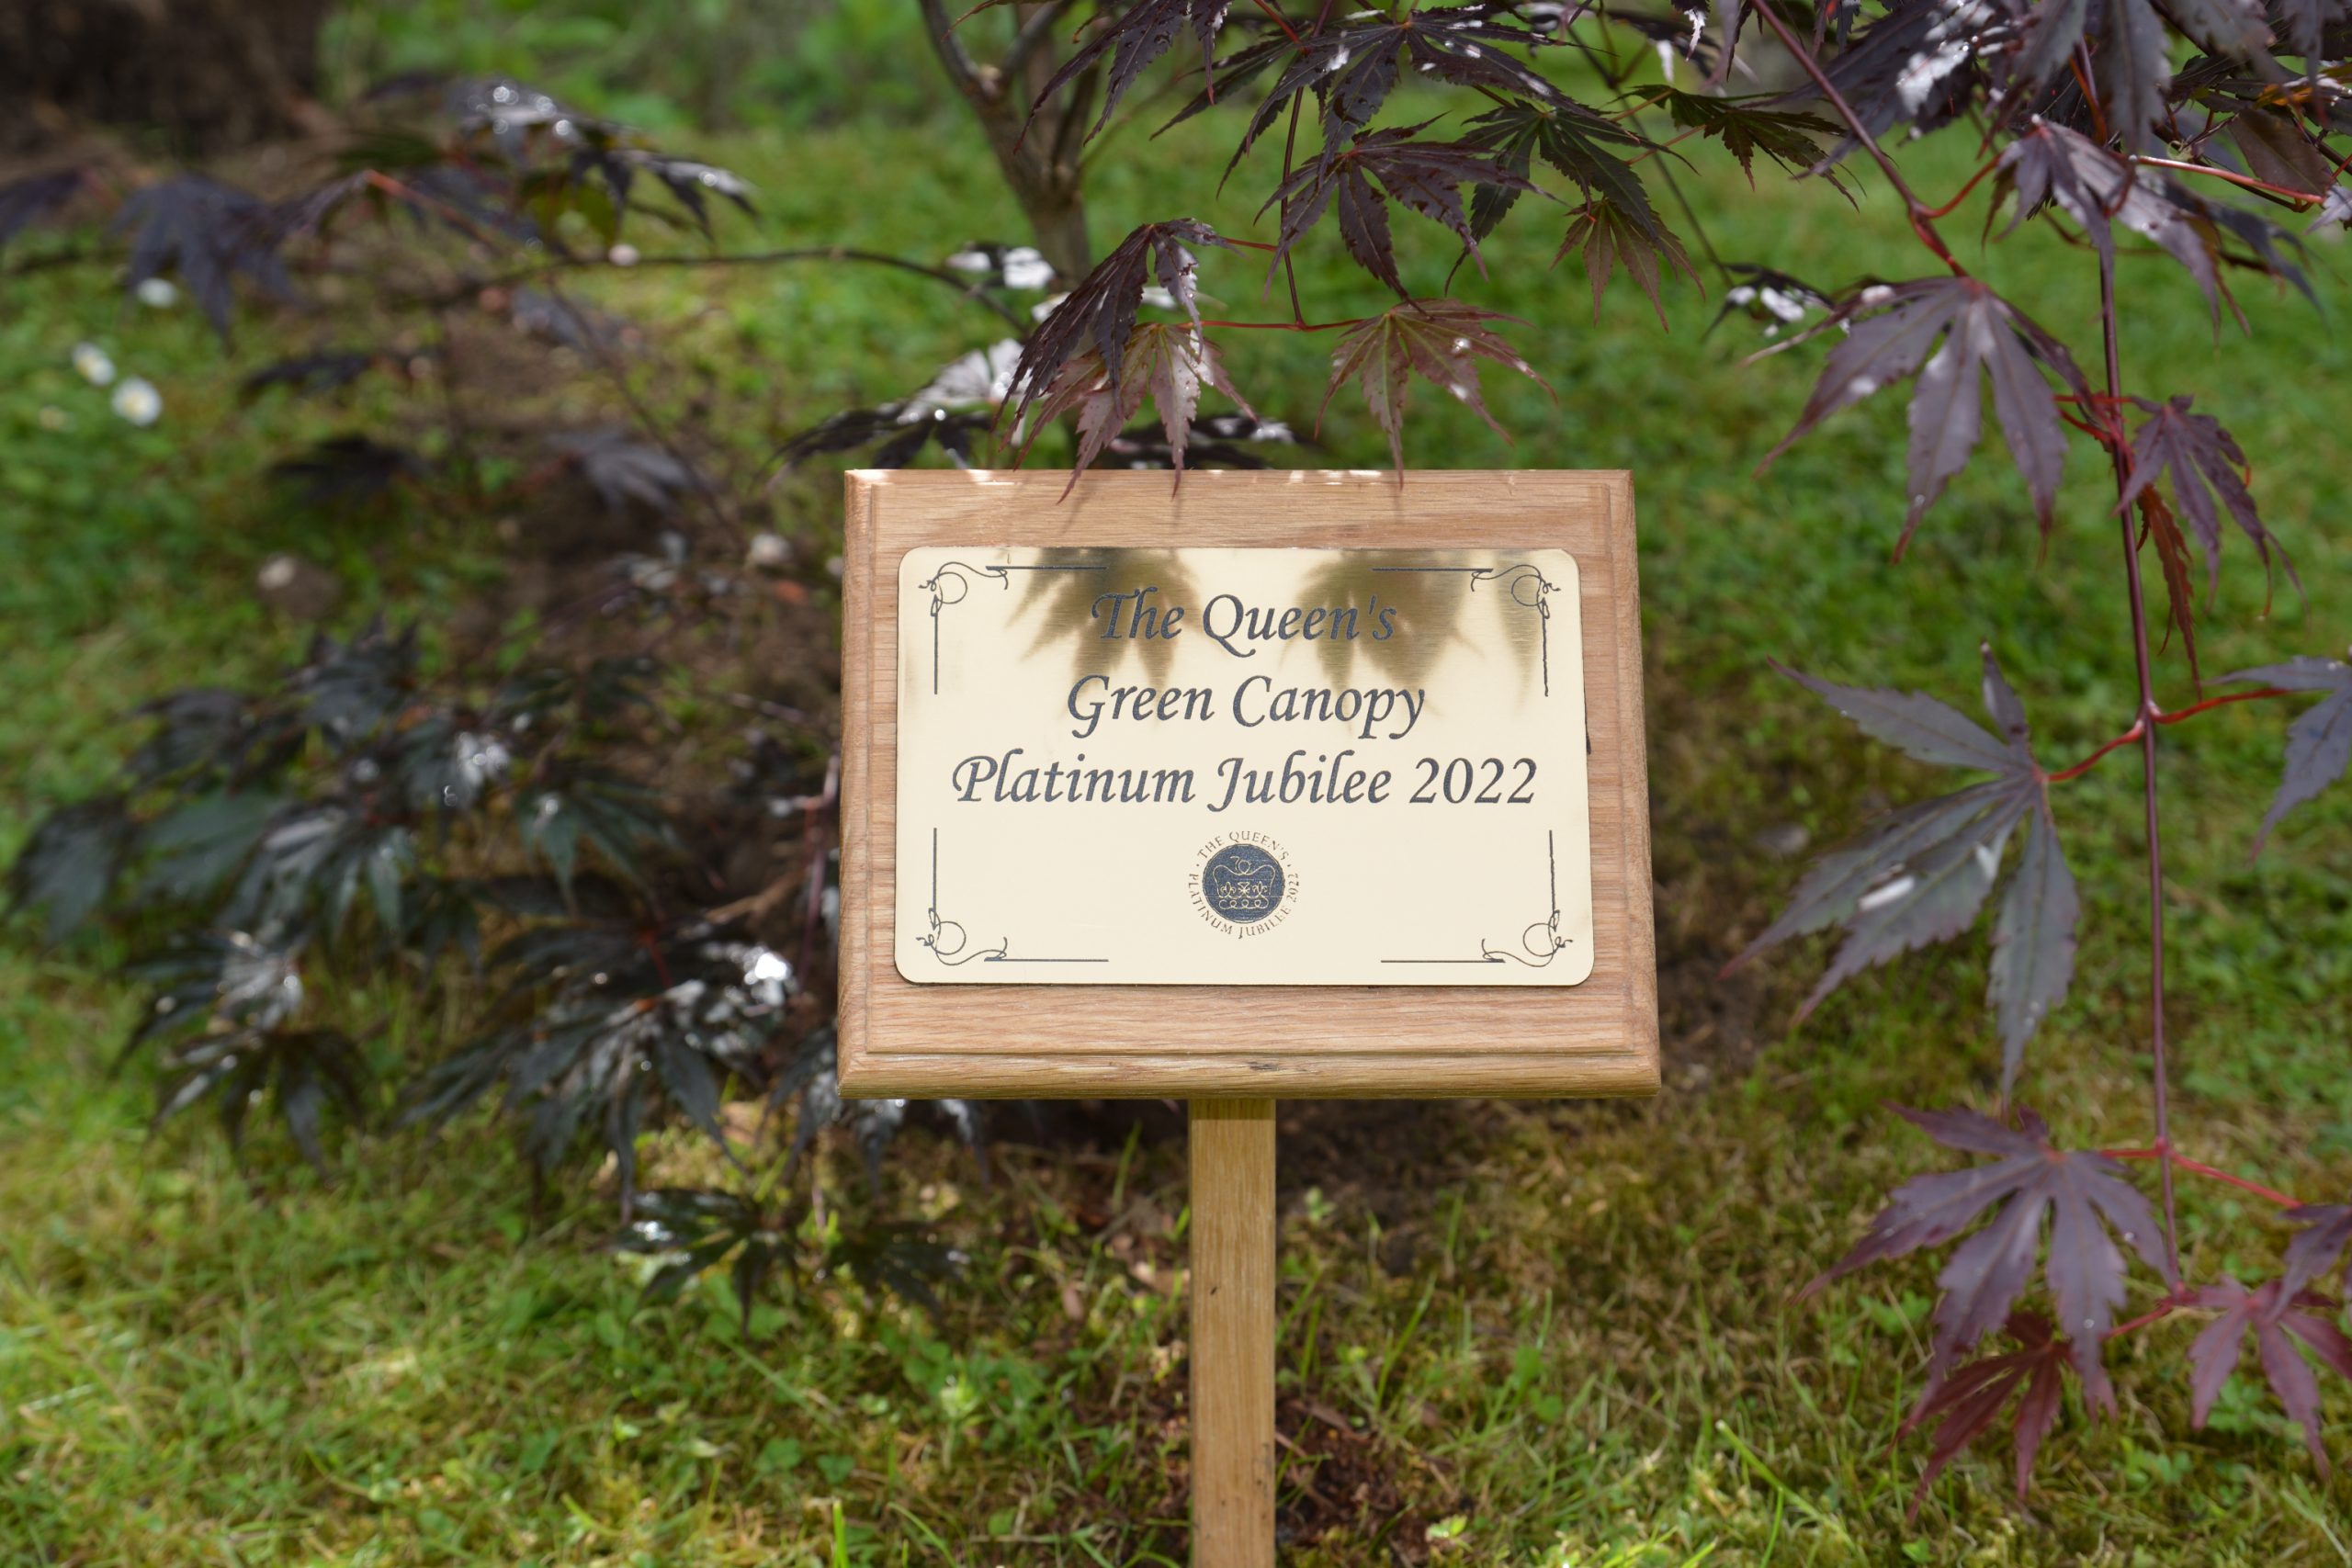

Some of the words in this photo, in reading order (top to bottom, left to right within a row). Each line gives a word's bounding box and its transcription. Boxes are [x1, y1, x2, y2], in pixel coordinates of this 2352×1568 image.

[1091, 586, 1184, 641] The
[1202, 594, 1397, 658] Queen's
[1068, 674, 1215, 739] Green
[1233, 675, 1425, 739] Canopy
[952, 749, 1194, 805] Platinum
[1207, 750, 1392, 812] Jubilee
[1408, 757, 1538, 805] 2022
[1197, 836, 1225, 859] THE
[1229, 830, 1290, 861] QUEEN'S
[1188, 874, 1233, 934] PLATINUM
[1238, 906, 1292, 939] JUBILEE
[1286, 873, 1299, 903] 2022
